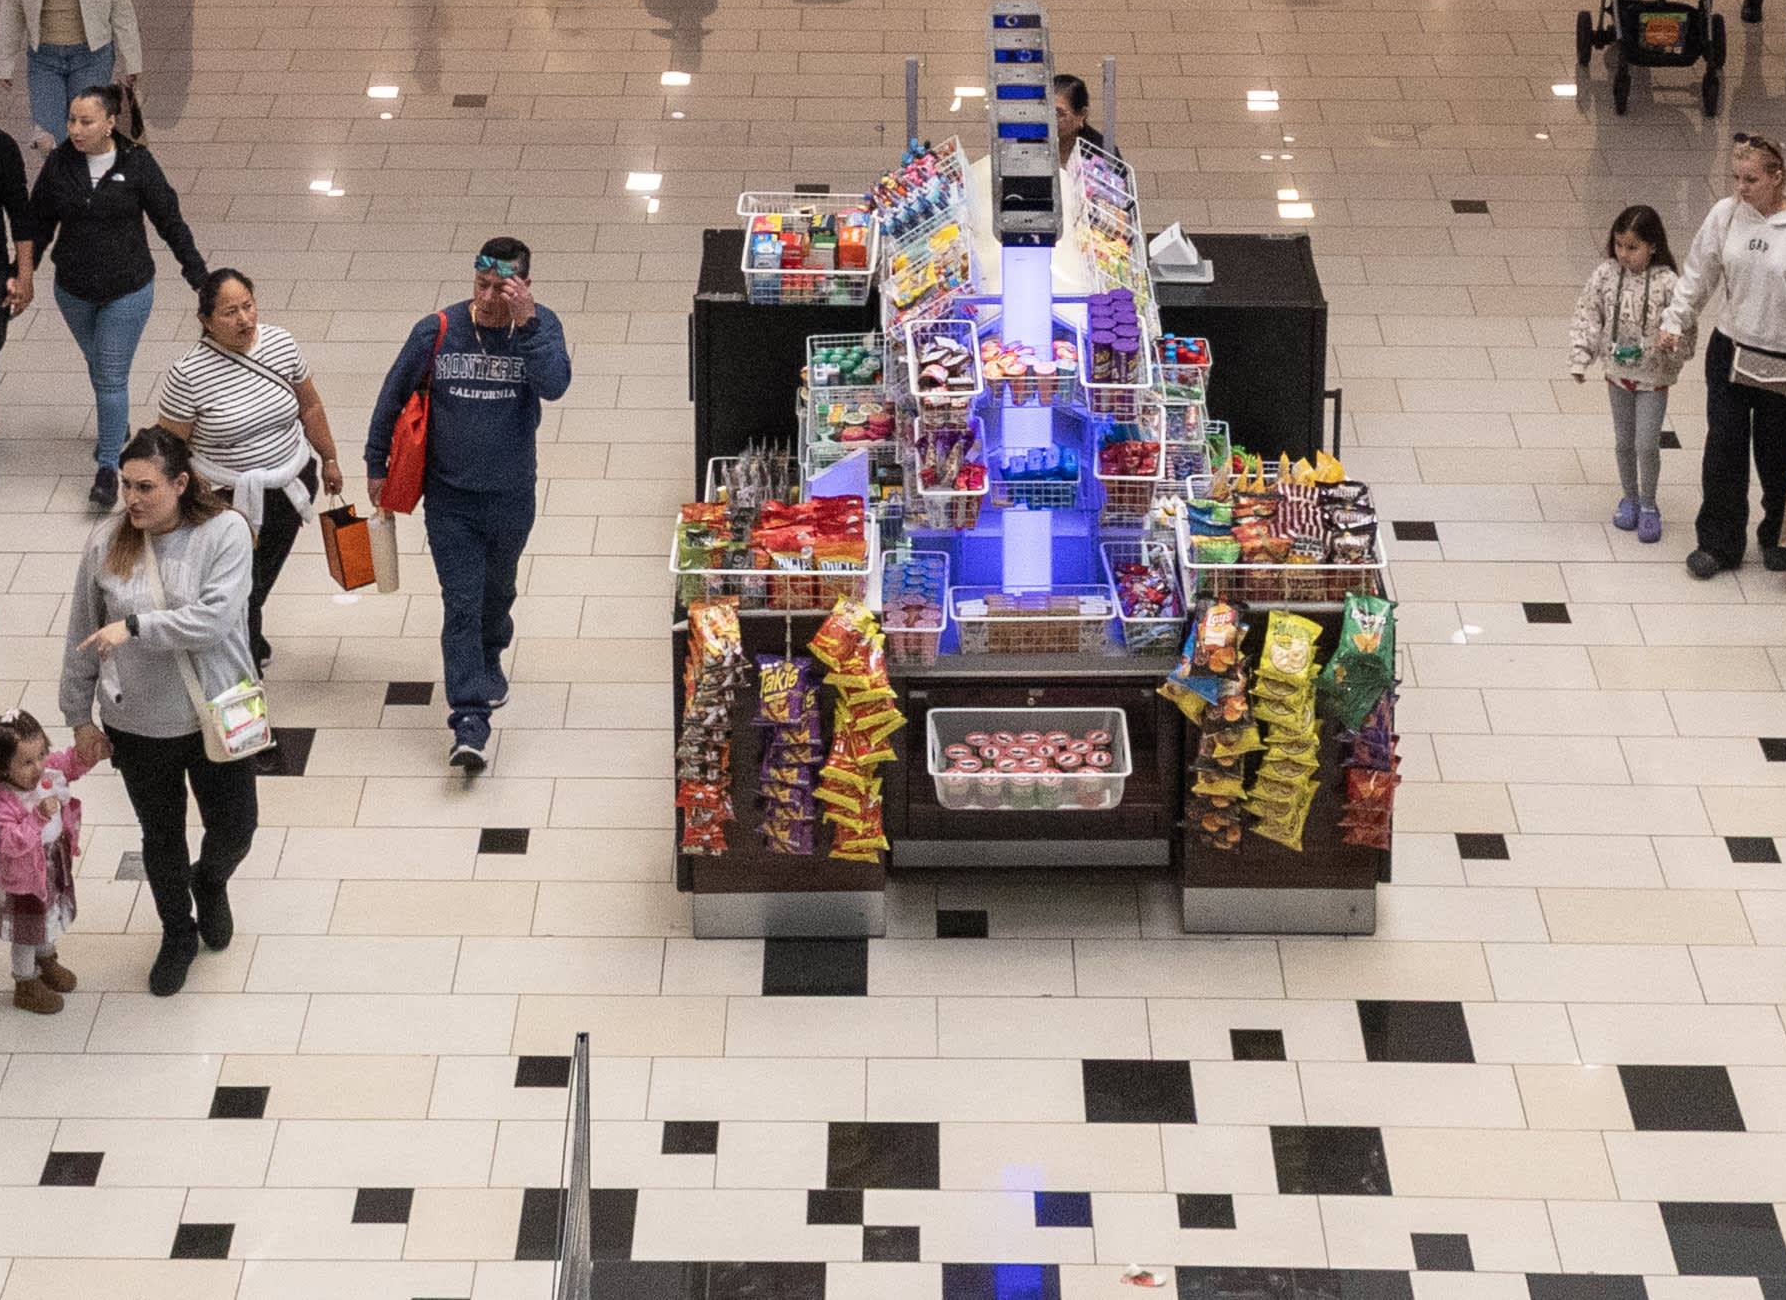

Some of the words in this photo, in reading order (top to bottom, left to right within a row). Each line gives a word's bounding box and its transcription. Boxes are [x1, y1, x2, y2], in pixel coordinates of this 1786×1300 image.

[435, 352, 529, 383] MONTERE
[449, 385, 517, 400] CALIFORNIA
[759, 663, 801, 696] Takis
